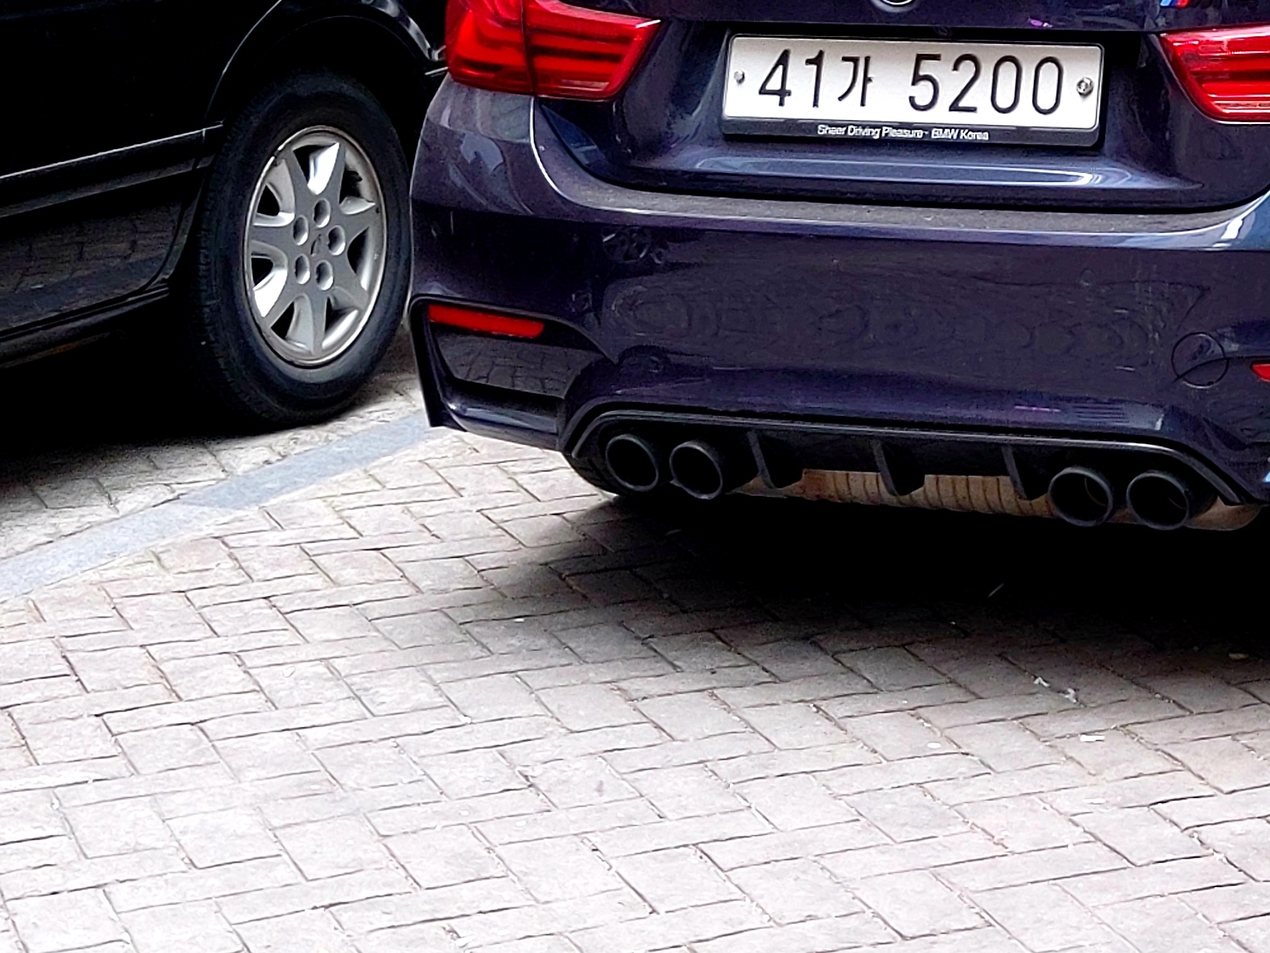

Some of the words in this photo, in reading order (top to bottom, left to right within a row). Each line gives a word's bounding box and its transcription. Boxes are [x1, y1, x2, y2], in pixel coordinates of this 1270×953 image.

[758, 49, 873, 108] 41가
[908, 53, 1064, 115] 5200
[817, 124, 846, 135] Sheer
[847, 125, 882, 139] Driving
[882, 126, 923, 139] Pleasure
[931, 128, 957, 139] BMW
[959, 129, 989, 141] Korea
